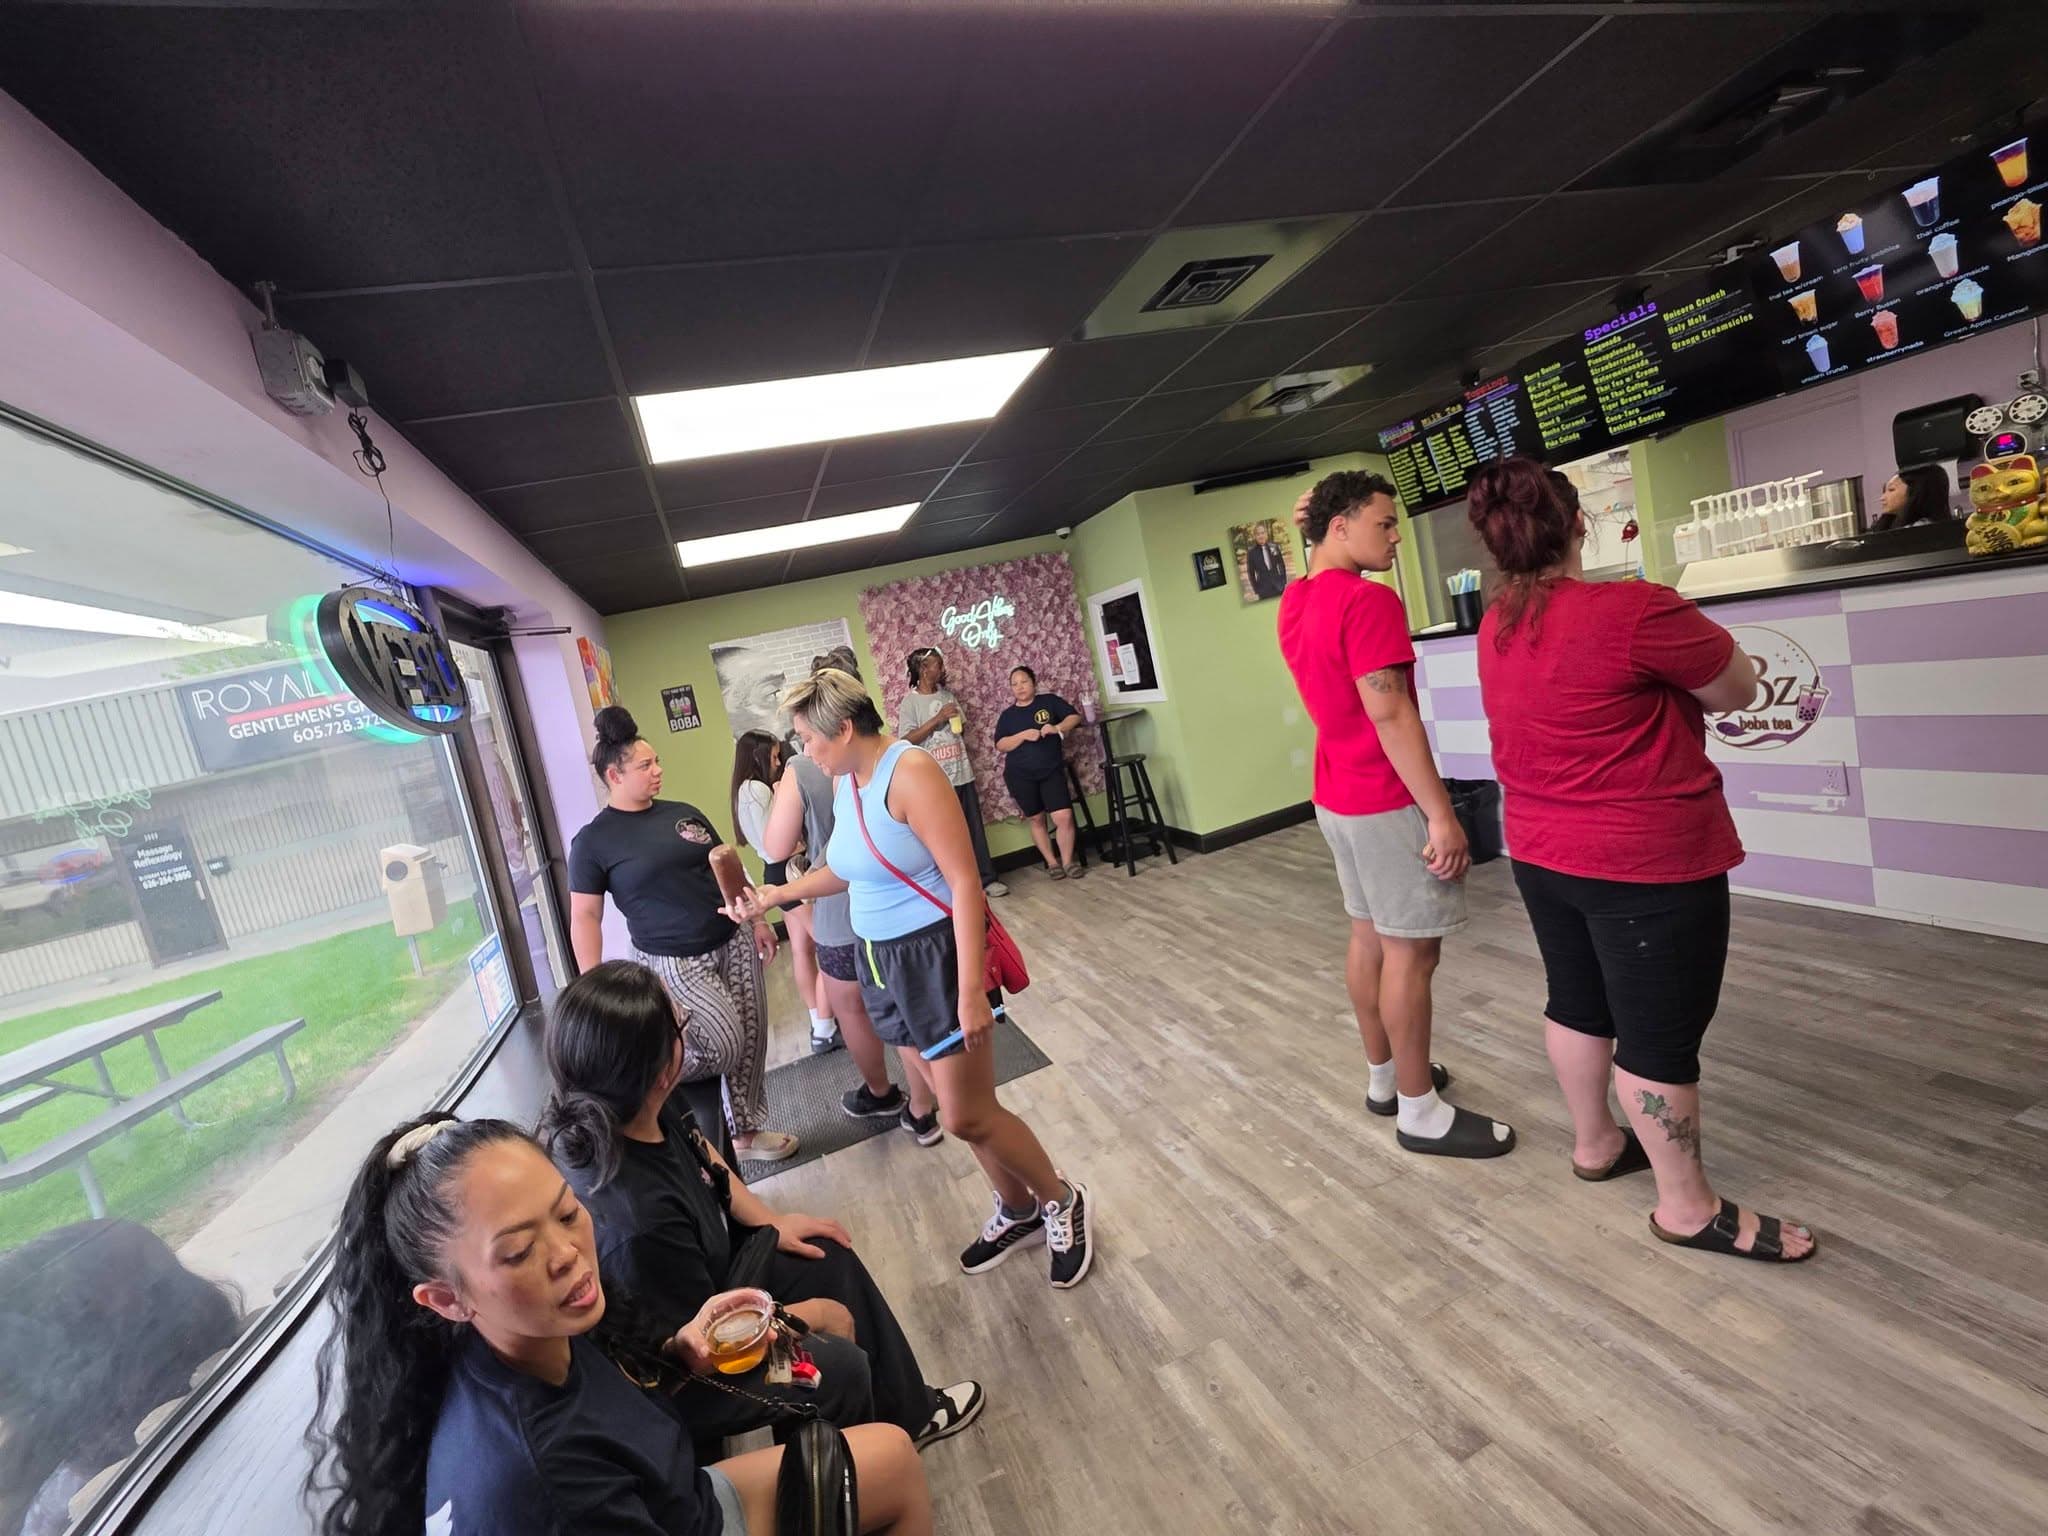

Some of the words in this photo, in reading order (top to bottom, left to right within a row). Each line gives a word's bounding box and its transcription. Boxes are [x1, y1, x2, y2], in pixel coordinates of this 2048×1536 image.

[1696, 288, 1726, 308] Crunch
[1584, 302, 1657, 340] Specials
[961, 620, 1004, 648] Only
[191, 670, 329, 721] ROYAL
[228, 703, 345, 740] GENTLEMEN'S
[669, 714, 700, 731] BOBA
[1738, 715, 1770, 730] boba
[1772, 716, 1793, 730] tea
[133, 849, 182, 870] Reflexology
[137, 843, 173, 859] Massage
